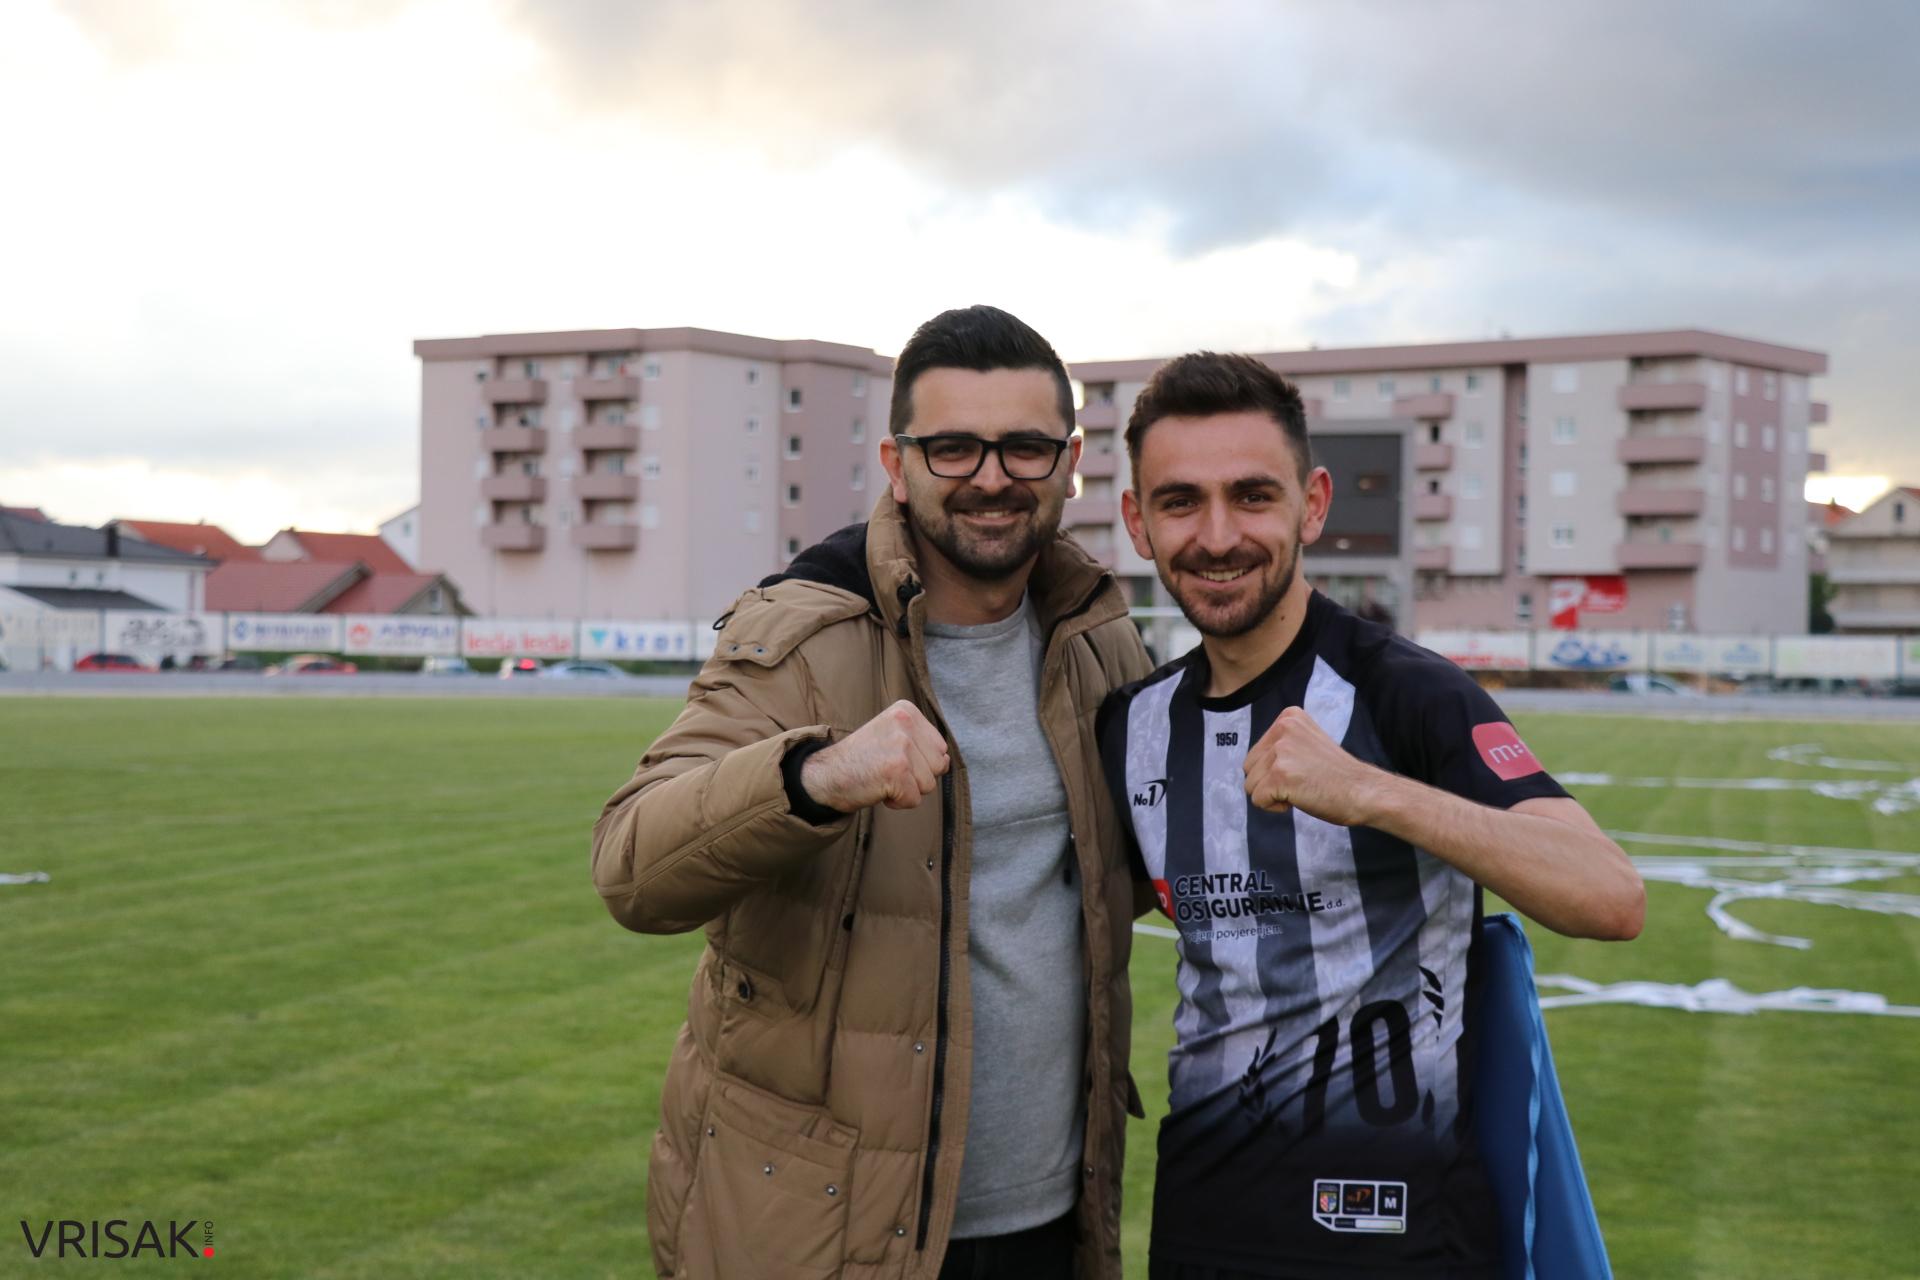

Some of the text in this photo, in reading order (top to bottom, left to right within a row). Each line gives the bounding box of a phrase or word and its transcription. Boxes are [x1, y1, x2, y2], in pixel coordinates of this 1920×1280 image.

[1216, 732, 1239, 747] 1950
[1174, 870, 1273, 897] CENTRAL
[1175, 891, 1325, 923] OSIGURANJE
[1301, 999, 1420, 1138] 10
[1384, 1196, 1397, 1209] M
